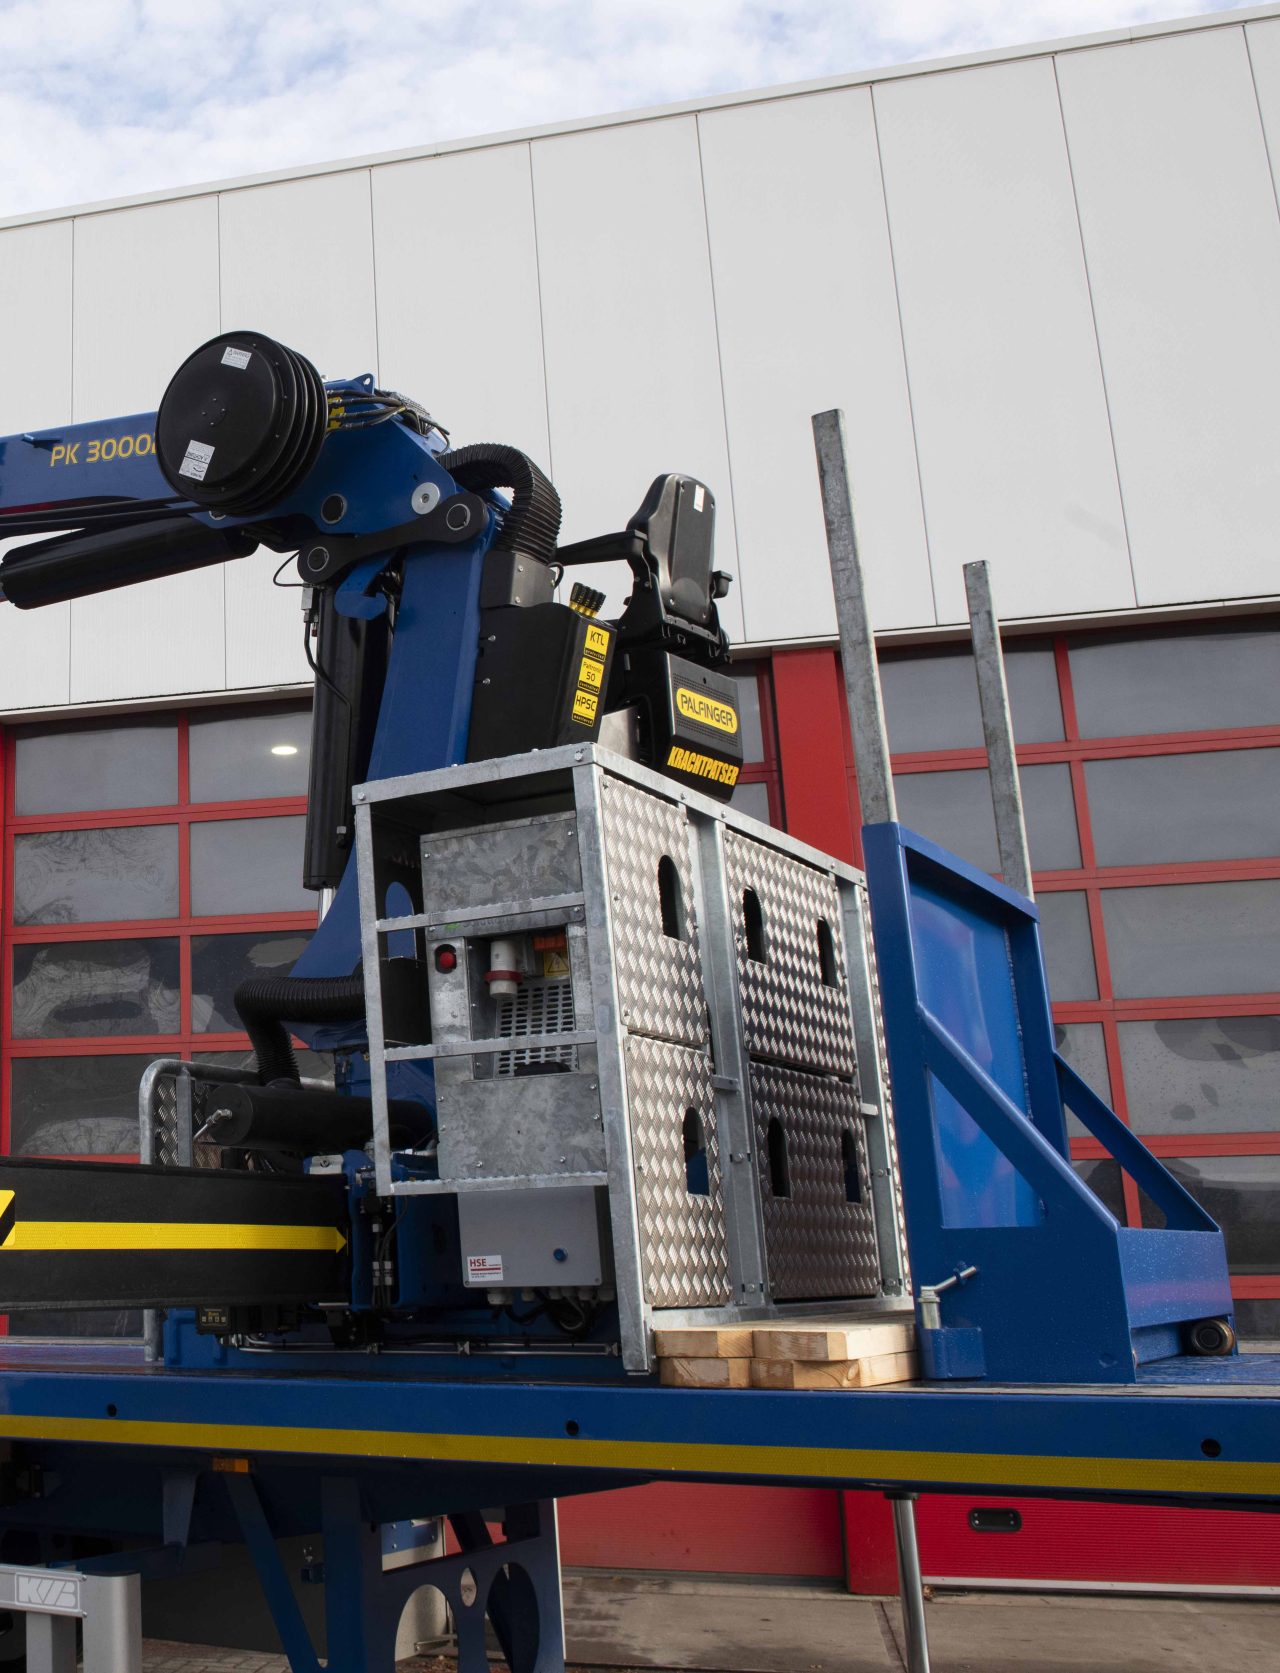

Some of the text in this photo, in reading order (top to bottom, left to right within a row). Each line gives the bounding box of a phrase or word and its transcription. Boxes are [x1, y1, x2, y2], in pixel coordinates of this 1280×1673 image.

[50, 443, 80, 467] PK
[589, 630, 605, 646] KTL
[586, 671, 596, 682] 50
[576, 694, 597, 712] HPSC
[680, 693, 734, 728] PALFINGER
[666, 745, 740, 786] KRACHTPATSER
[469, 1258, 487, 1267] HSE
